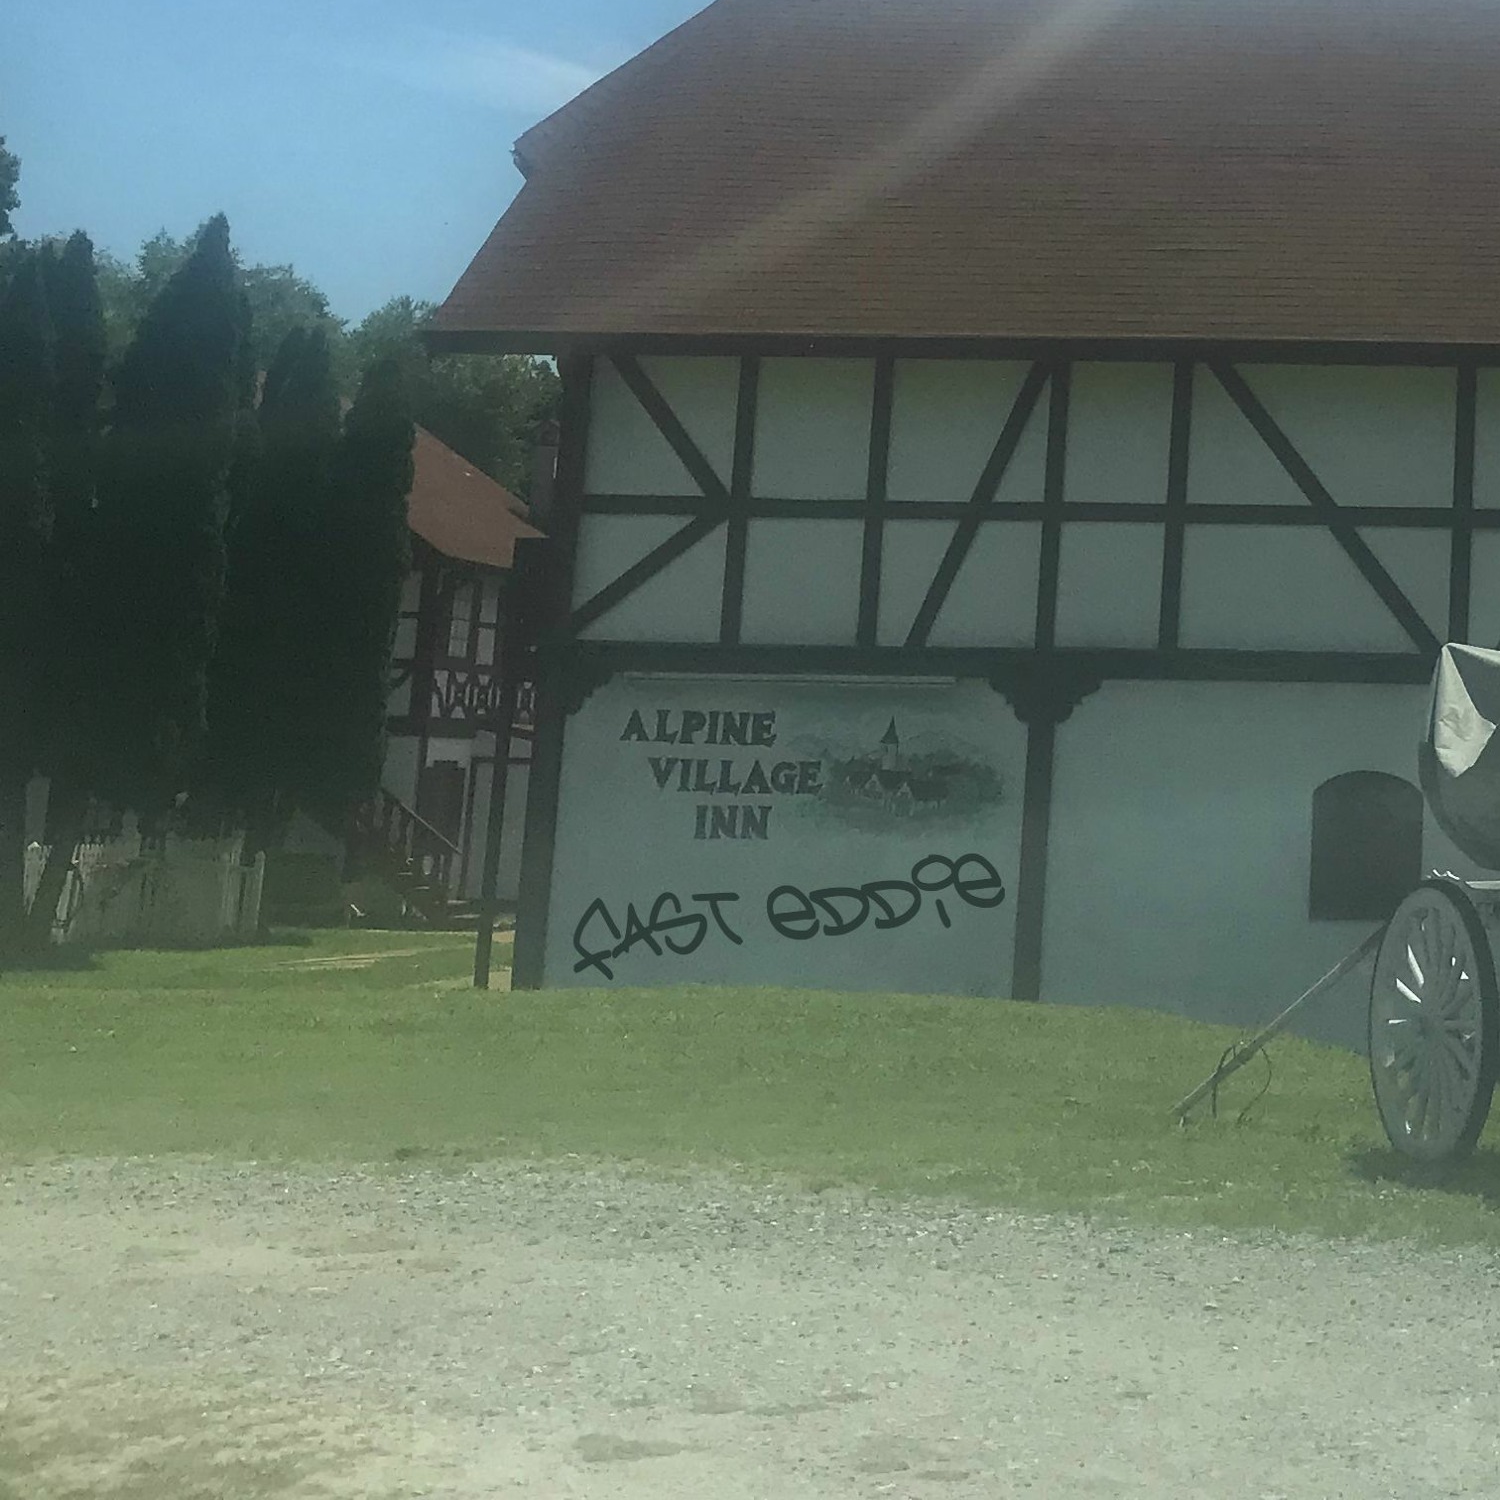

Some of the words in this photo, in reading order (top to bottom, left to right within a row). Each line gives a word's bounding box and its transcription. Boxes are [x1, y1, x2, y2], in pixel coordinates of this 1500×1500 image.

[620, 709, 777, 747] ALPINE
[648, 757, 824, 796] VILLAGE
[694, 805, 772, 840] INN
